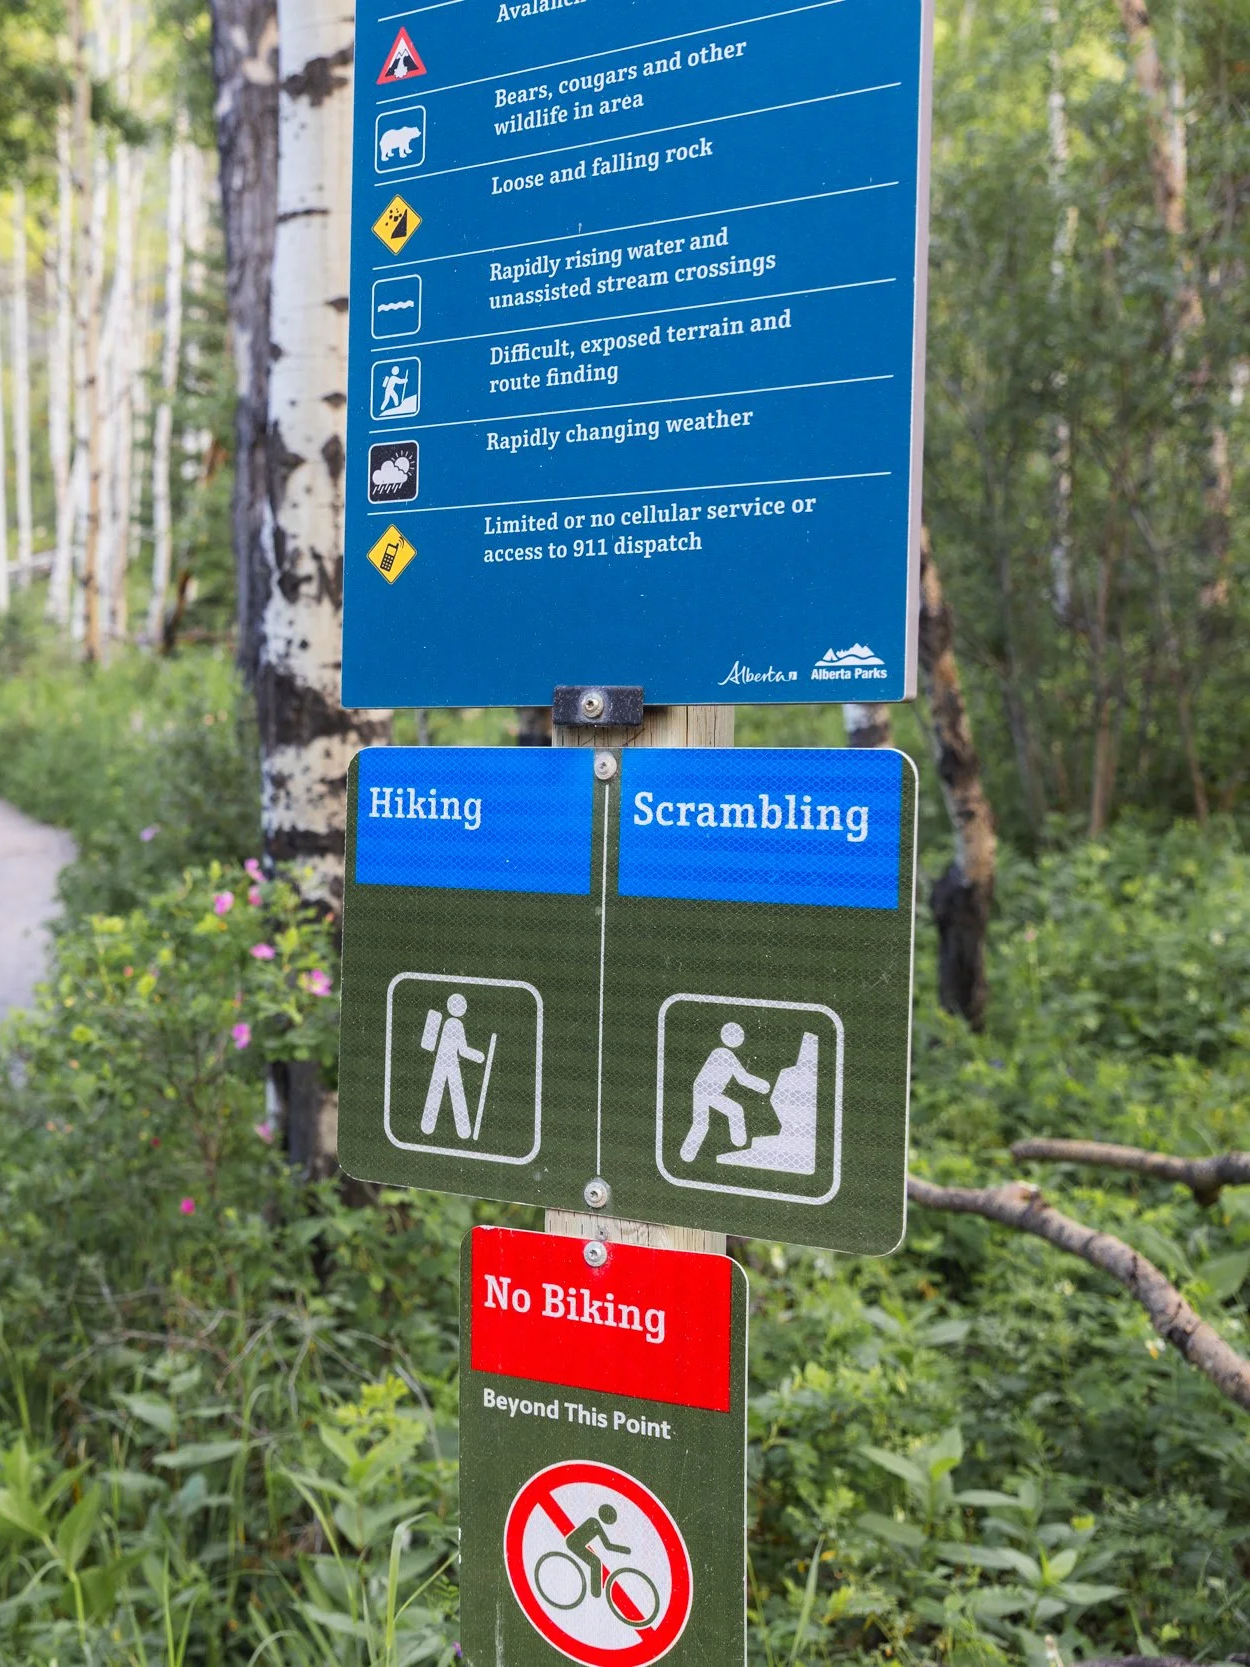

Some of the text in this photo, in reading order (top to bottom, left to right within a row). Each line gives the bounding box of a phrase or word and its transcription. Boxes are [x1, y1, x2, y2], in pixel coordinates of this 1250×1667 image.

[496, 0, 587, 23] Avalanc
[494, 40, 746, 107] Bears, cougars and other
[494, 91, 644, 135] wildlife in area
[492, 138, 712, 194] Loose and falling rock
[489, 227, 728, 285] Rapidly rising water and
[489, 254, 776, 309] unassisted stream crossings
[490, 309, 791, 365] Difficult, exposed terrain and
[490, 364, 618, 392] route finding
[487, 408, 753, 453] Rapidly changing weather
[484, 496, 816, 534] Limited or no cellular service or
[484, 532, 702, 562] access to 911 dispatch
[718, 661, 786, 685] Alberta
[811, 668, 888, 680] Alberta Parks
[369, 787, 482, 830] Hiking
[634, 792, 868, 842] Scrambling
[484, 1275, 665, 1343] No Biking
[483, 1388, 671, 1439] Beyond This Point
